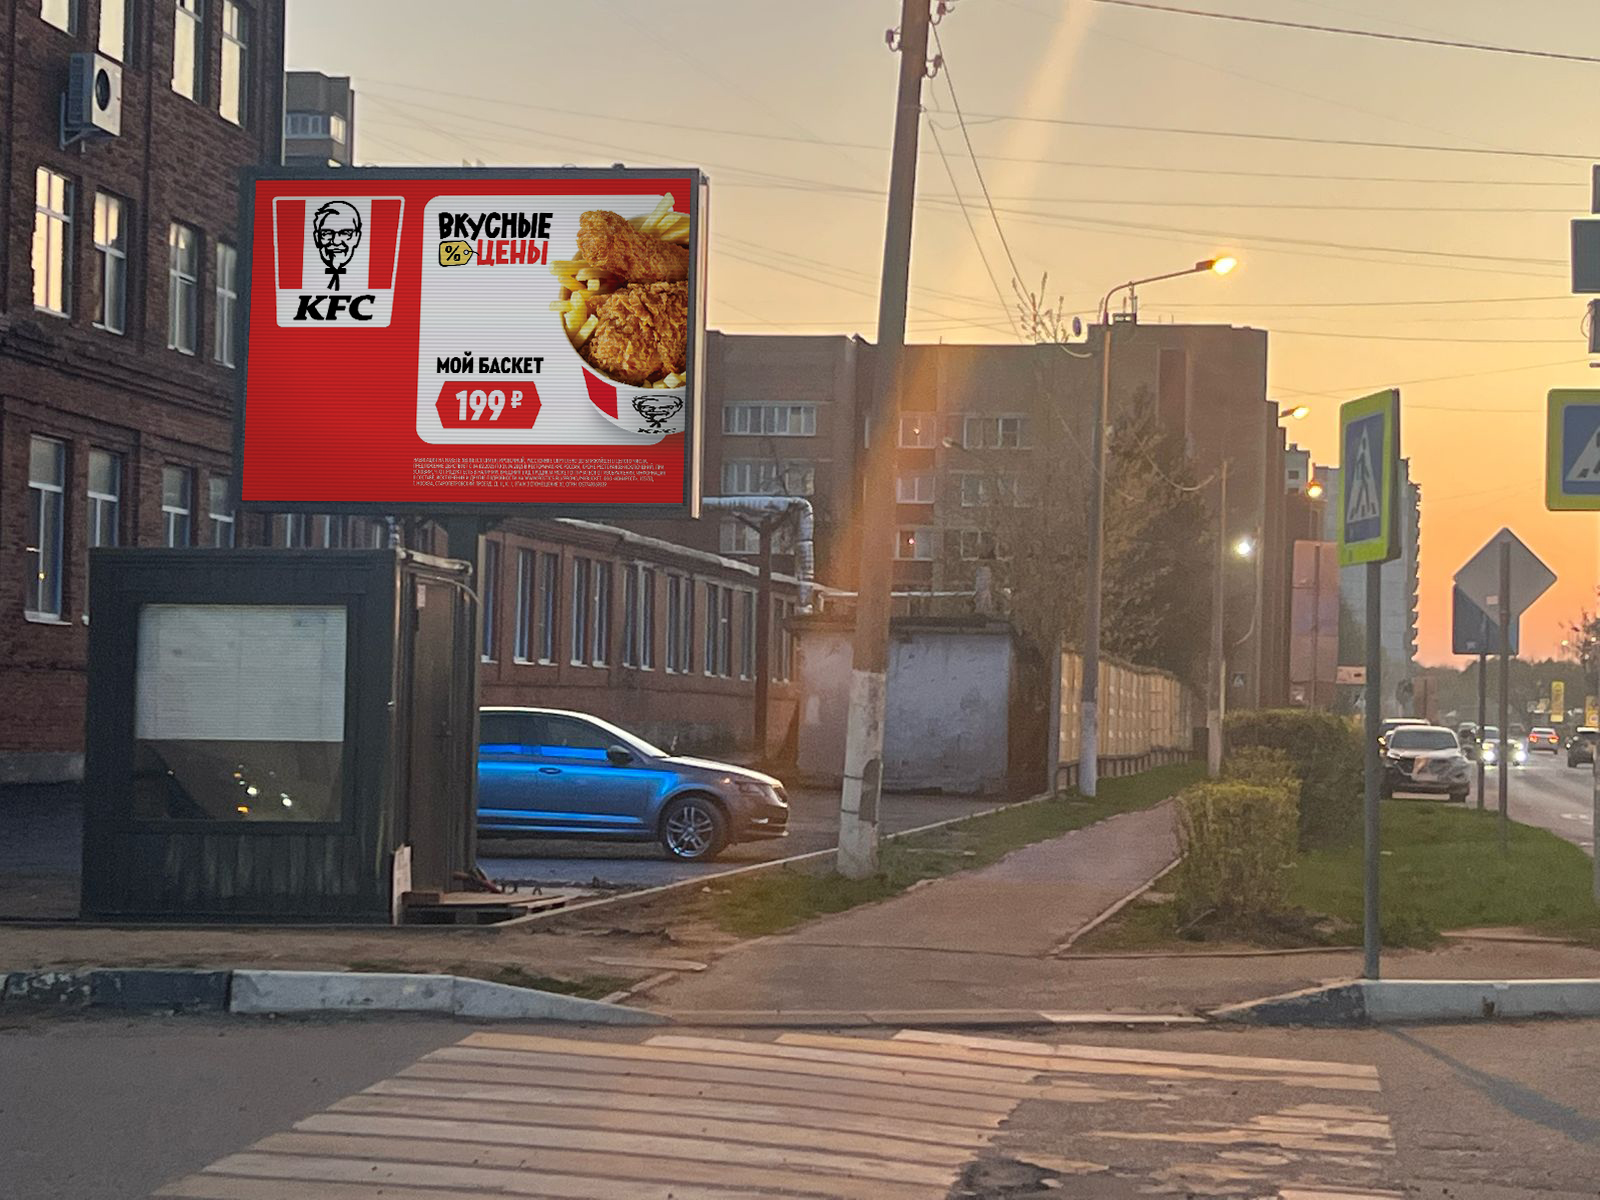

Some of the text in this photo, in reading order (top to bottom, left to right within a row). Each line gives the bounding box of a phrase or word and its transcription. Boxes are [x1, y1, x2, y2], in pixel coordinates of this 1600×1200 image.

[438, 211, 554, 241] ВКУСНЫЕ
[476, 239, 549, 267] ЦЕНЫ
[293, 294, 376, 321] KFC
[436, 351, 544, 374] МОЙ БАСКЕТ
[455, 390, 505, 421] 199
